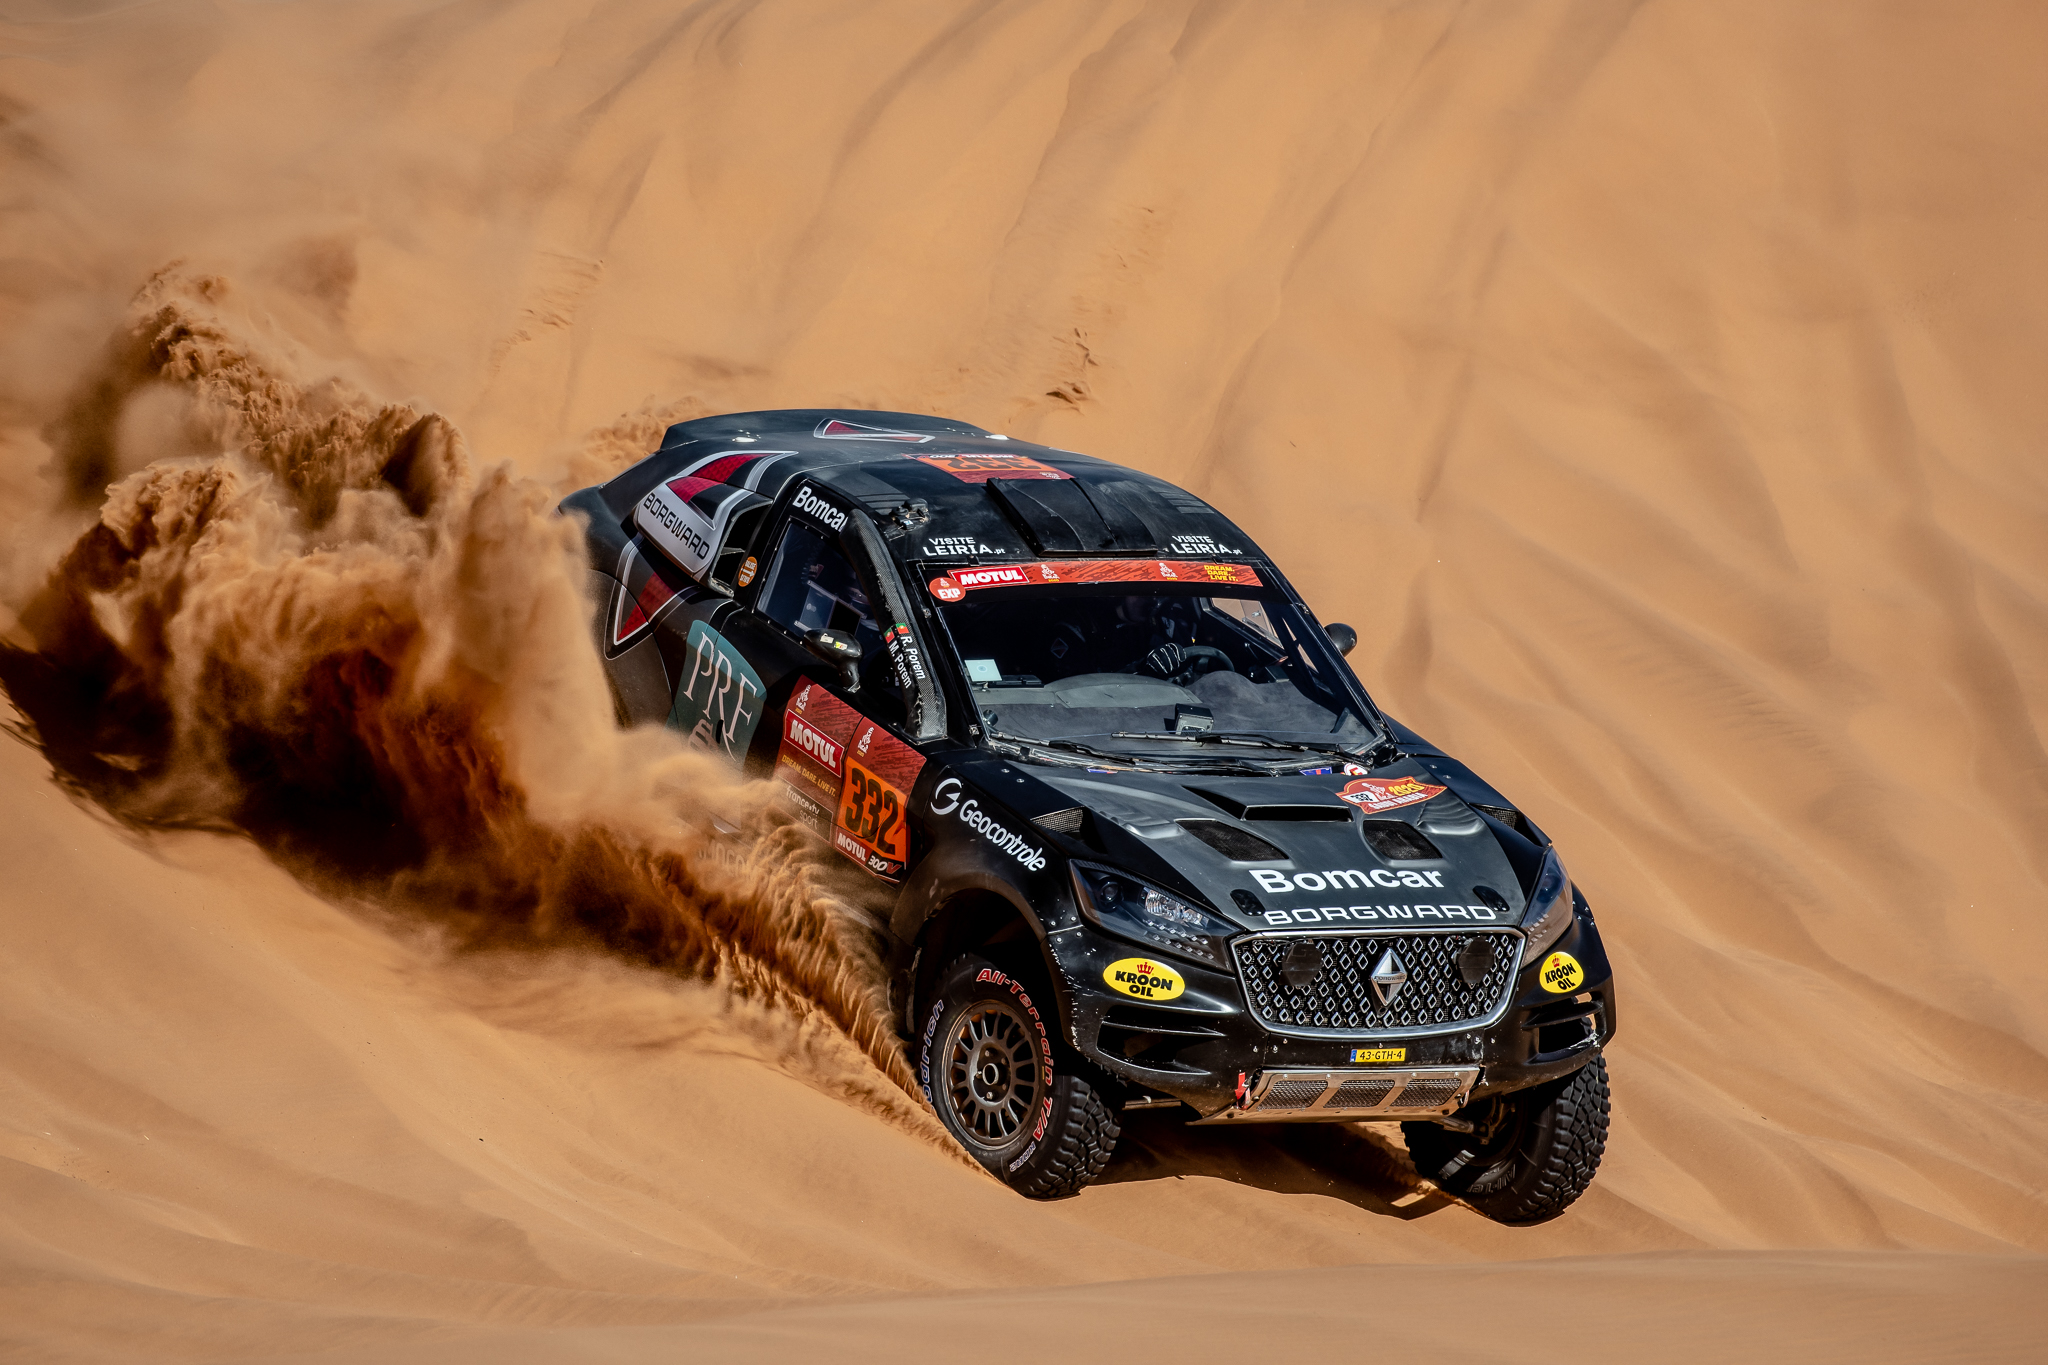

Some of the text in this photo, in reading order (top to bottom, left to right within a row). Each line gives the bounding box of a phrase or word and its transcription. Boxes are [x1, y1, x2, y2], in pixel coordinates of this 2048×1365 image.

[643, 492, 710, 560] BORGWARD
[929, 537, 976, 546] VISITE
[1172, 535, 1214, 543] VISITE
[923, 544, 1006, 557] LEIRIA.pt
[960, 569, 1023, 585] MOTUL
[937, 588, 961, 599] EXP
[889, 640, 912, 689] M. Porem
[900, 636, 926, 679] R. Porem
[789, 719, 837, 768] MOTUL
[817, 779, 830, 793] LIVE
[1388, 783, 1425, 796] 2020
[844, 767, 899, 856] 332
[960, 799, 1046, 872] Geocontrole
[837, 832, 902, 874] MOTUL 300V
[1249, 869, 1445, 893] Bomcar
[1264, 905, 1498, 925] BORGWARD
[1115, 970, 1173, 991] KROON
[1544, 963, 1577, 984] KROON
[1557, 977, 1576, 990] OIL
[1128, 985, 1154, 998] OIL
[975, 968, 1054, 1142] All-Terrain T/A
[1359, 1050, 1403, 1061] 43-GTH-4
